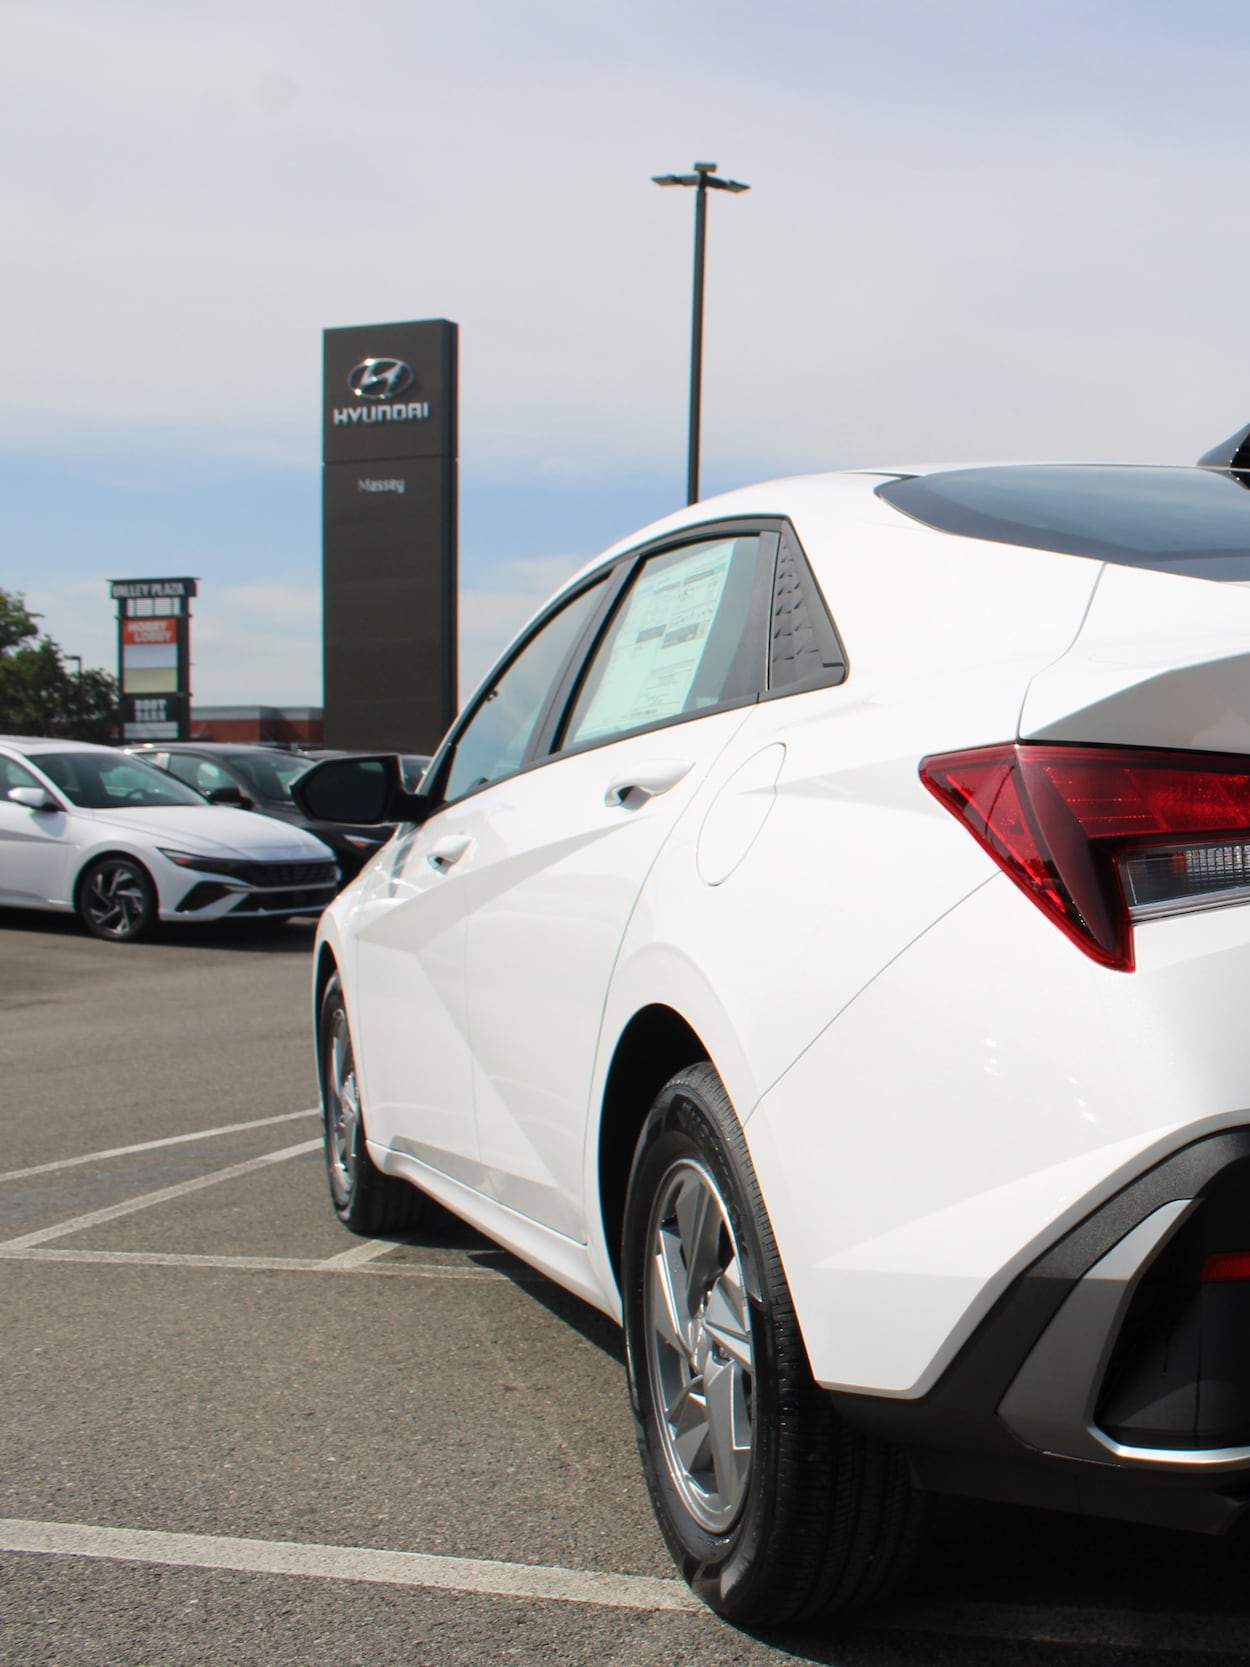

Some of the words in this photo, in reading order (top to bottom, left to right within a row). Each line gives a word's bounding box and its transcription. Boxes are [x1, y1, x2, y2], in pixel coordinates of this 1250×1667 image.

[333, 402, 429, 425] HYUNDAI
[358, 478, 405, 493] Massey
[151, 582, 185, 596] PLAZA
